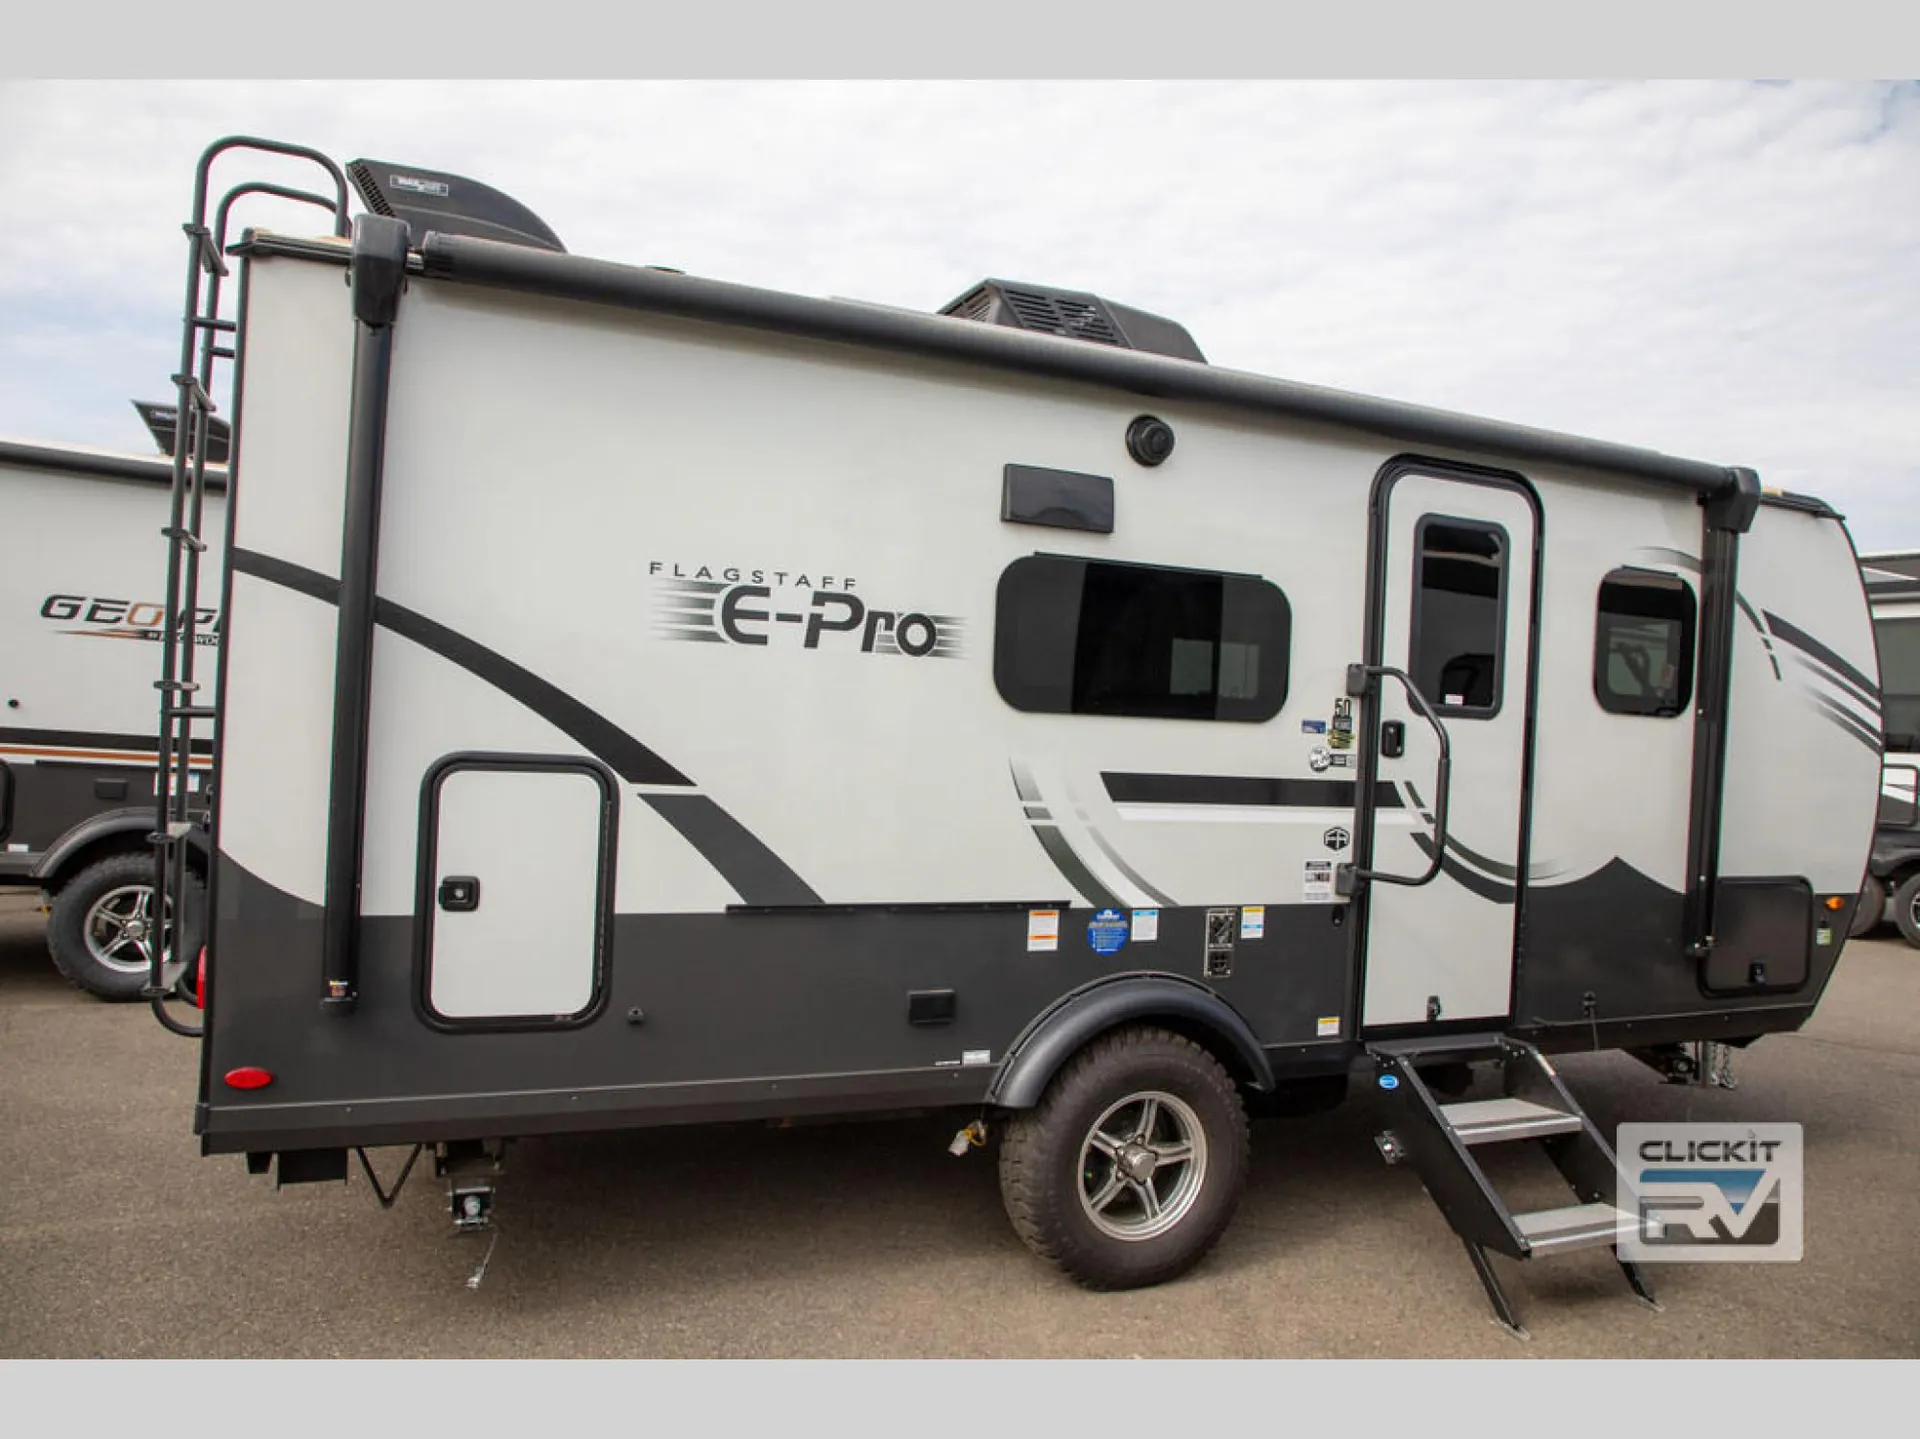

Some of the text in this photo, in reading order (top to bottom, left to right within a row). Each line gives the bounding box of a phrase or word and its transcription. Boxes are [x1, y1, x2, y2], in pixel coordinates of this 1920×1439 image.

[649, 561, 857, 591] FLAGSTAFF
[40, 594, 166, 628] GEO
[721, 584, 938, 658] E-Pro
